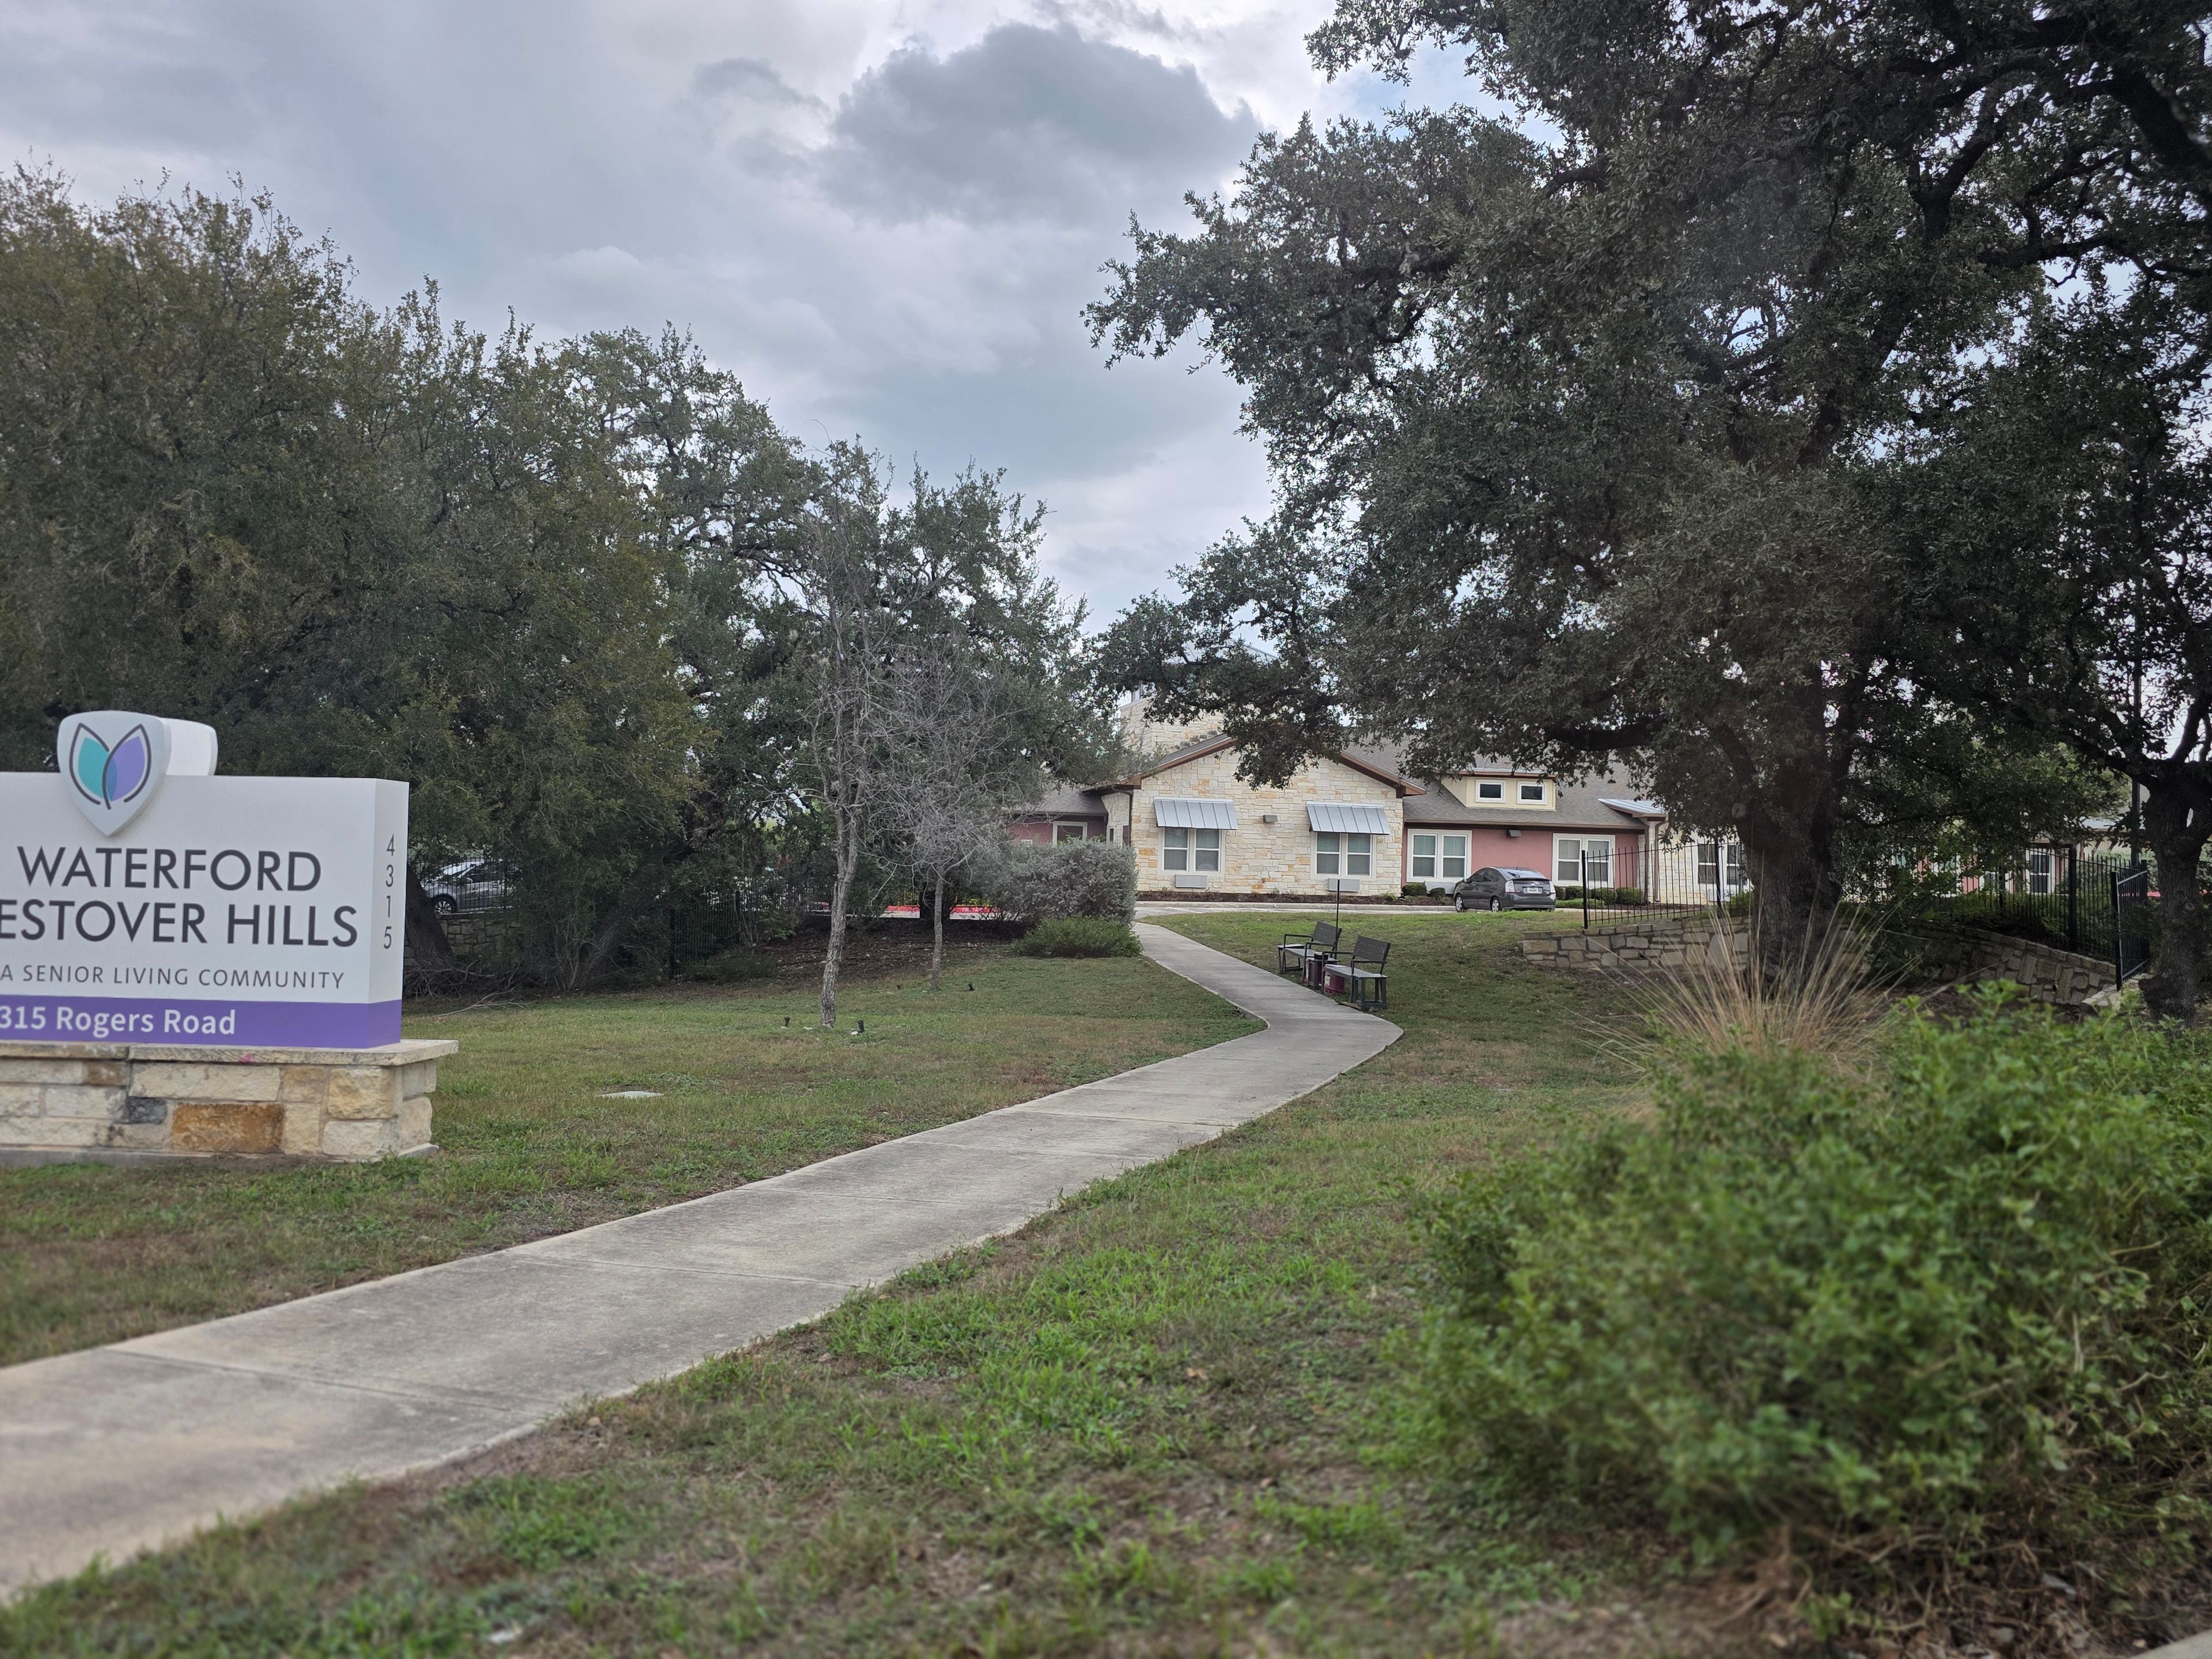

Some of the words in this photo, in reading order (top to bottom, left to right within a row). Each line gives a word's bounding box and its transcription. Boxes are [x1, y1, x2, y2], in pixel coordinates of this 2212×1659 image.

[17, 846, 321, 891] WATERFORD
[382, 834, 396, 949] 4315
[227, 904, 358, 948] HILLS
[0, 964, 13, 981] A
[23, 964, 104, 983] SENIOR
[113, 967, 188, 985] LIVING
[198, 969, 344, 989] COMMUNITY
[56, 1006, 154, 1039] Rogers
[164, 1009, 236, 1035] Road
